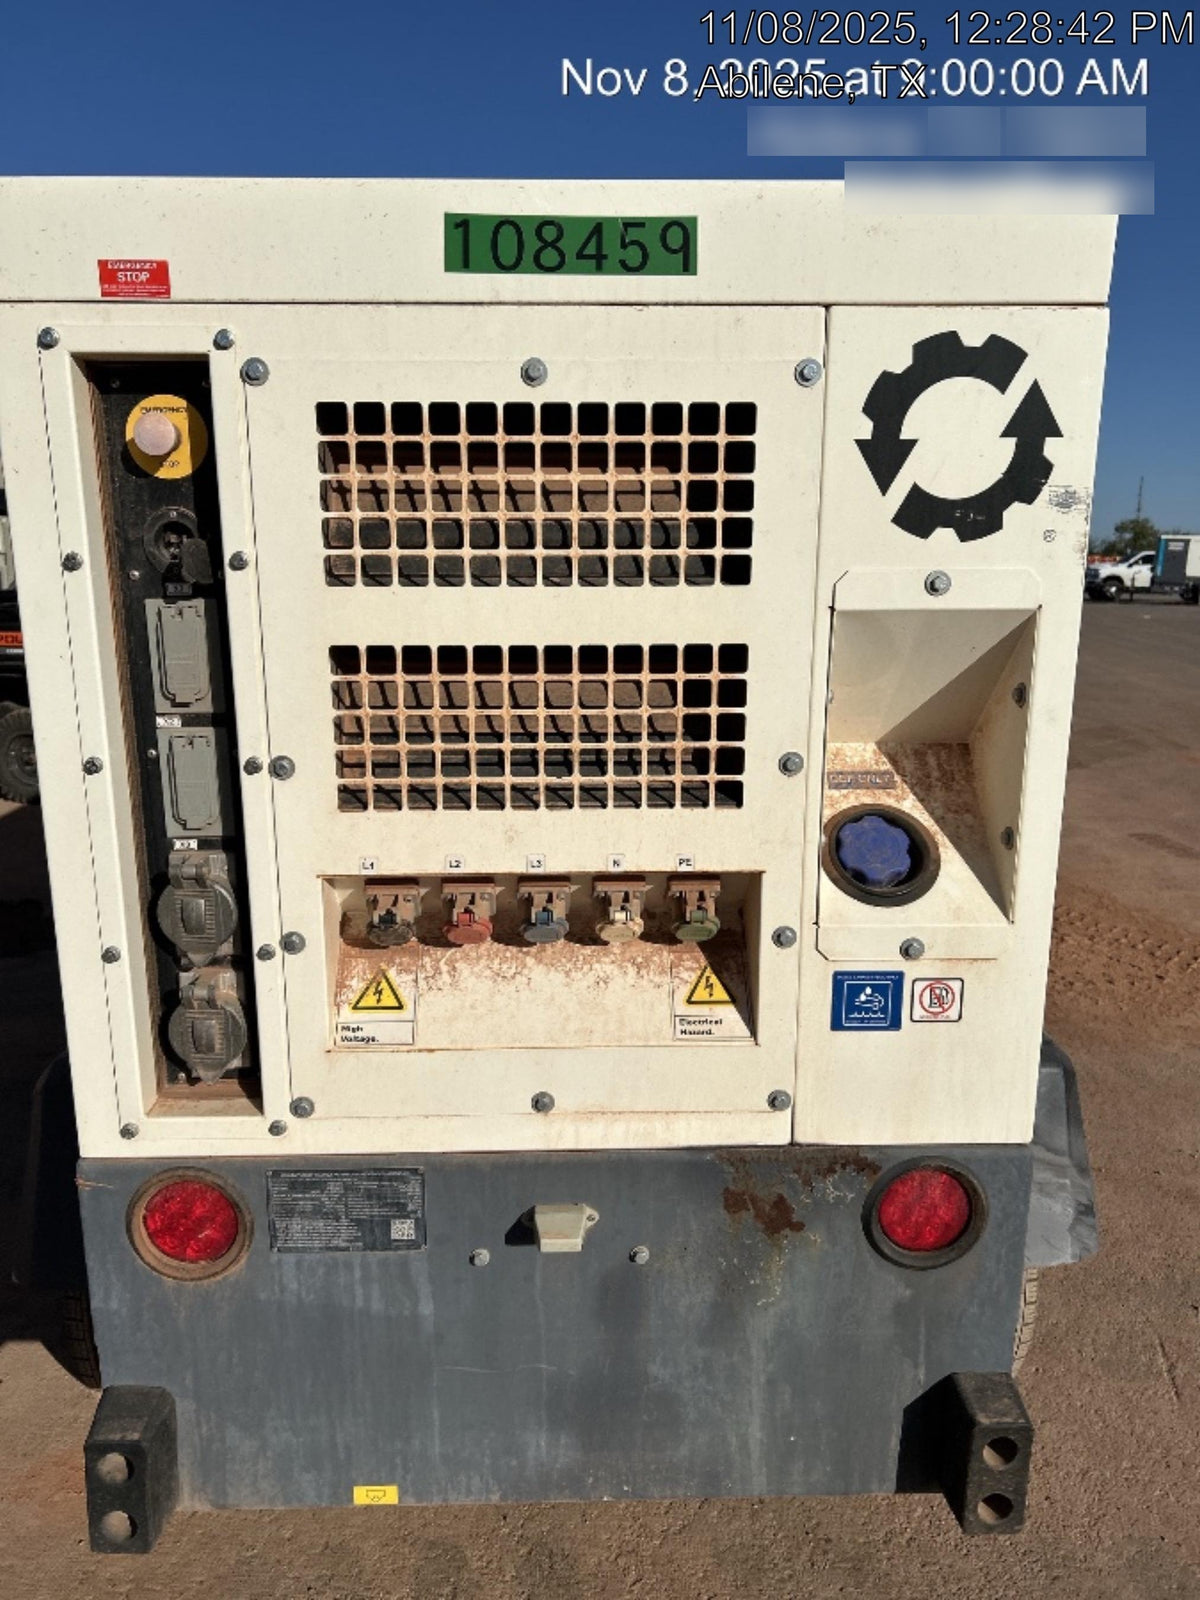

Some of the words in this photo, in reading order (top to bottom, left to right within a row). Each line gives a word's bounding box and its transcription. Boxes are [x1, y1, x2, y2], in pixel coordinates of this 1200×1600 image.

[453, 218, 691, 272] 108459
[117, 271, 149, 283] STOP
[362, 859, 374, 870] L1
[449, 859, 462, 868] L2
[678, 858, 692, 867] PE
